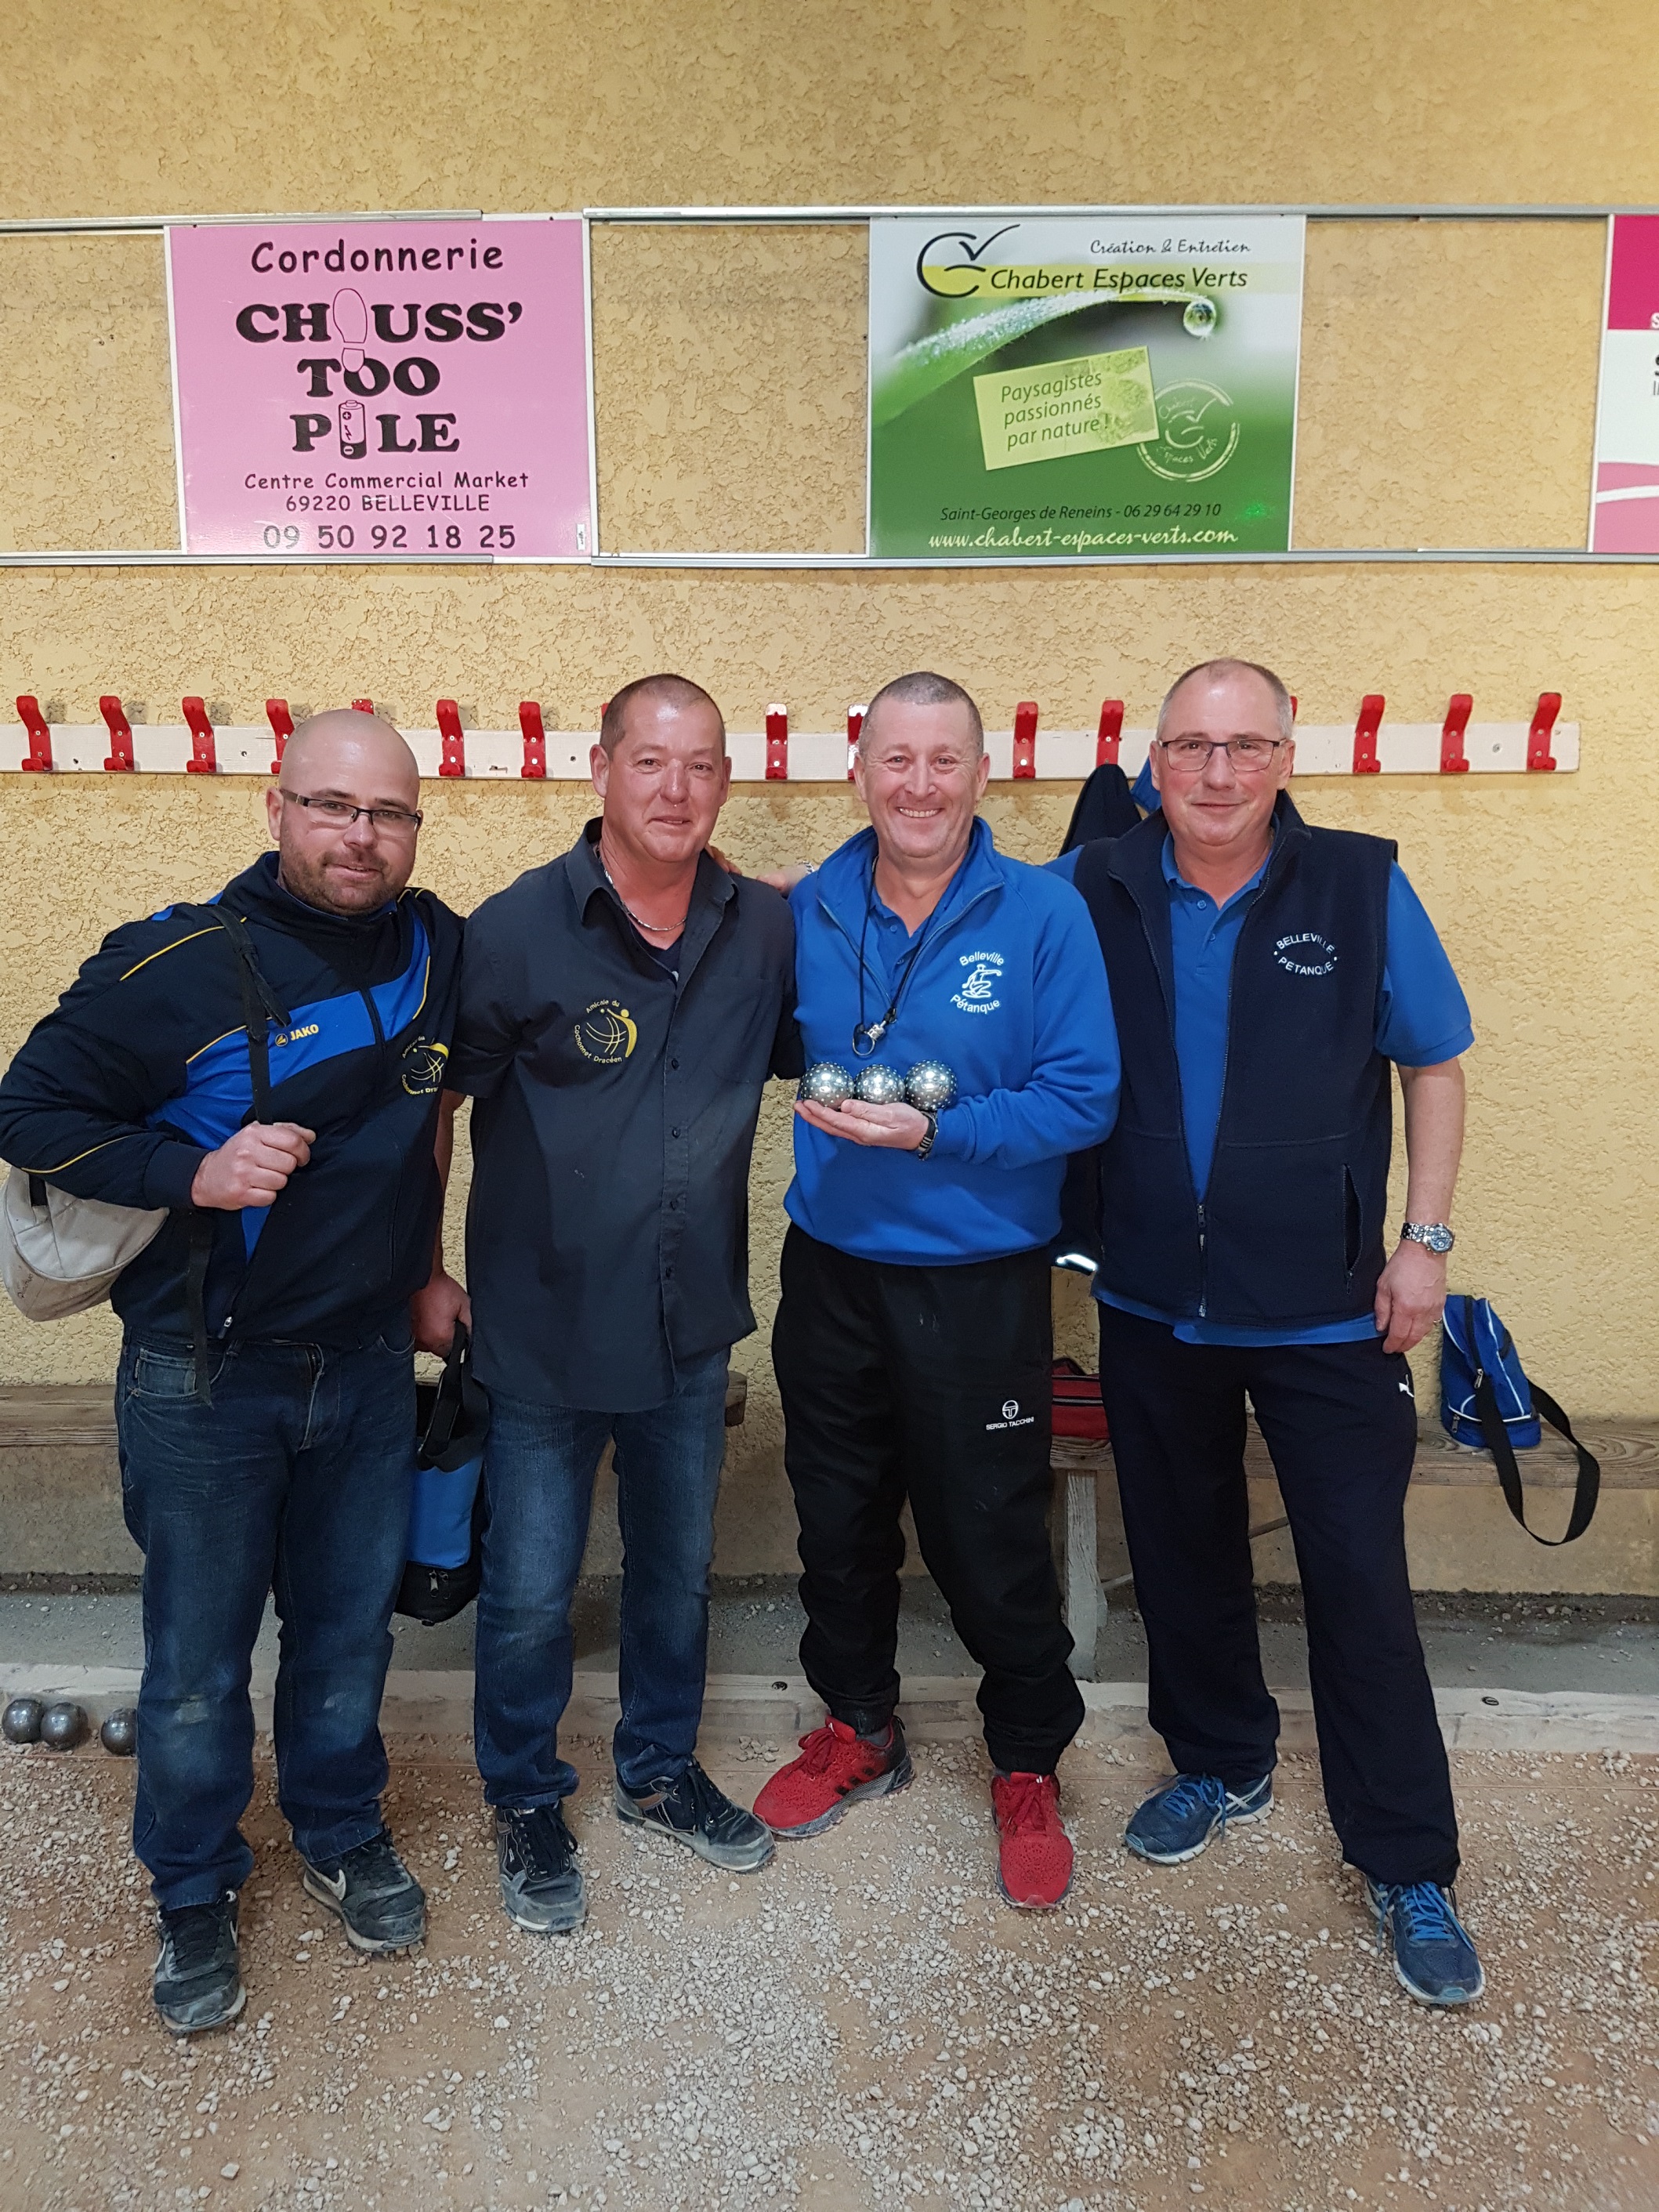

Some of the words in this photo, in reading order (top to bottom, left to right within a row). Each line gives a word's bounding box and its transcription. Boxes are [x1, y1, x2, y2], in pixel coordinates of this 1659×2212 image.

[252, 238, 503, 273] Cordonnerie
[1090, 239, 1156, 254] Création
[1161, 238, 1172, 253] &
[1178, 238, 1251, 253] Entretien
[991, 269, 1084, 289] Chabert
[1093, 268, 1185, 294] Espaces
[1192, 267, 1248, 288] Verts
[297, 357, 440, 397] TOO
[1002, 373, 1102, 404] Paysagistes
[1004, 393, 1101, 429] passionnés
[1008, 430, 1037, 451] par
[245, 473, 313, 489] Centre
[325, 472, 442, 488] Commercial
[455, 471, 528, 488] Market
[286, 495, 350, 512] 69220
[362, 494, 490, 512] BELLEVILLE
[940, 507, 1036, 523] Saint-Georges
[1039, 505, 1056, 520] de
[1060, 505, 1112, 520] Reneins
[1124, 505, 1141, 517] 06
[1143, 504, 1161, 517] 29
[1164, 504, 1180, 516] 64
[1183, 504, 1201, 516] 29
[1205, 503, 1221, 516] 10
[263, 525, 300, 548] 09
[317, 525, 355, 548] 50
[371, 524, 408, 548] 92
[427, 524, 462, 548] 18
[480, 524, 516, 548] 25
[929, 525, 1238, 552] www.chabert-espaces-verts.com
[1276, 932, 1335, 954] BELLEVILLE
[959, 951, 1005, 966] Belleville
[1278, 956, 1334, 976] PETANQUE
[950, 994, 1000, 1014] Pétanque
[290, 1023, 319, 1041] JAKO
[986, 1421, 1008, 1430] SERGIO
[1009, 1416, 1034, 1427] TACCHINI
